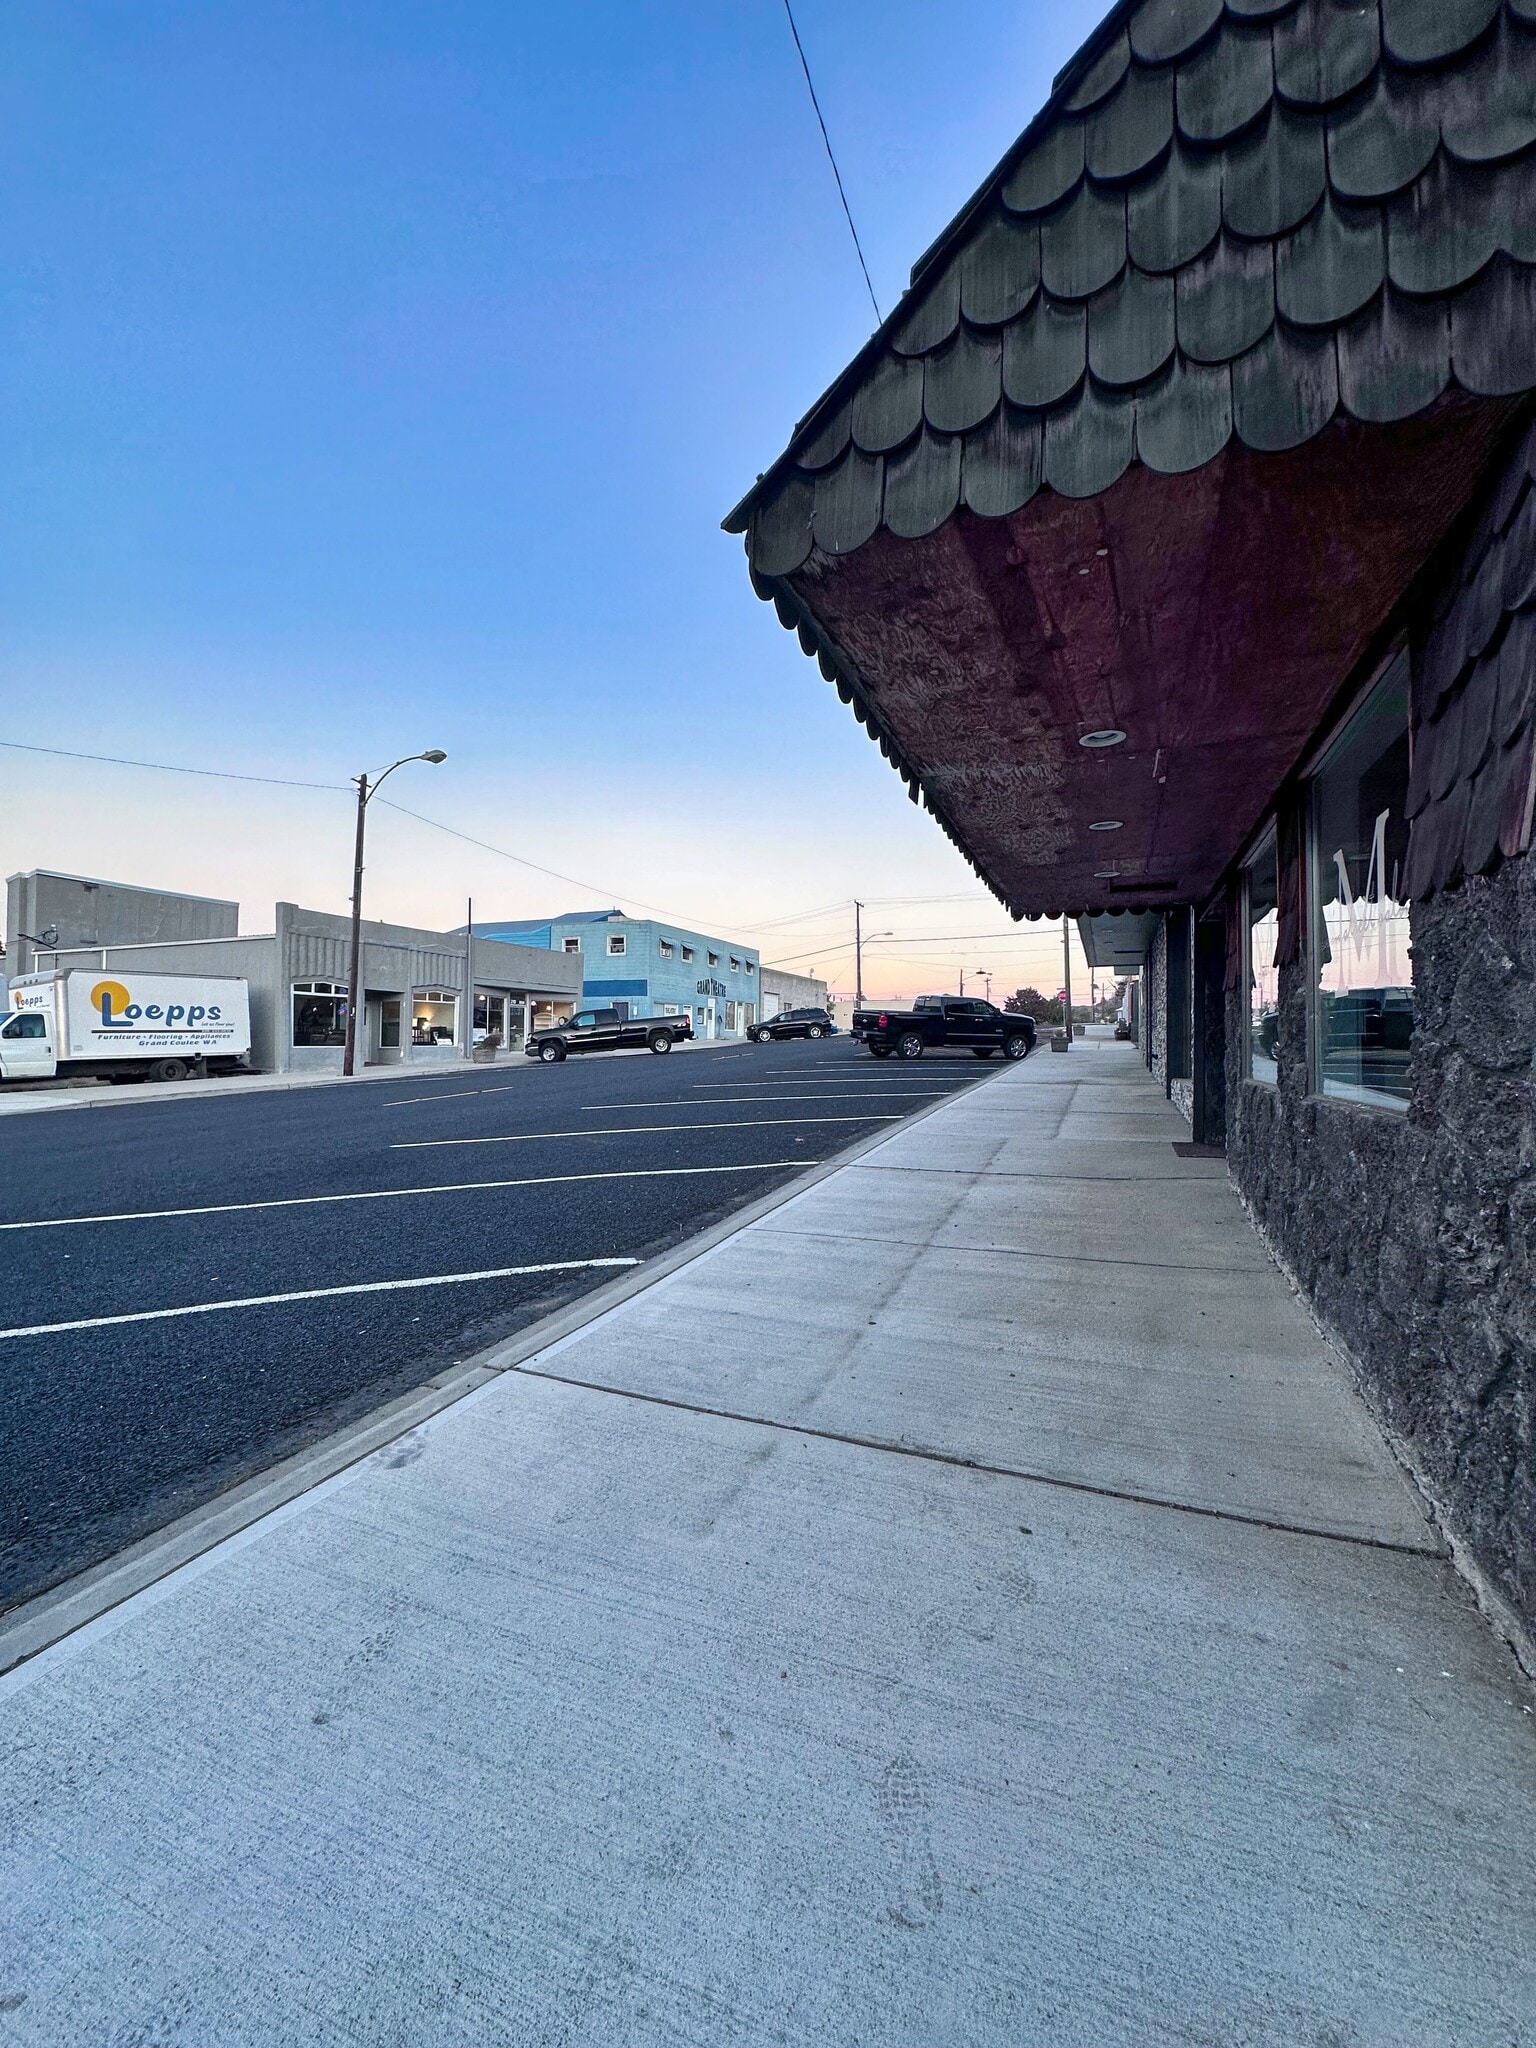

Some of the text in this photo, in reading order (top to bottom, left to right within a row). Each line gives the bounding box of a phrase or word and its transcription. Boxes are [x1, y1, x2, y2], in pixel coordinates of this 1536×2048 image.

[697, 978, 726, 997] GRAND THEATRE
[17, 996, 43, 1010] Loepps
[102, 992, 221, 1027] Loepps
